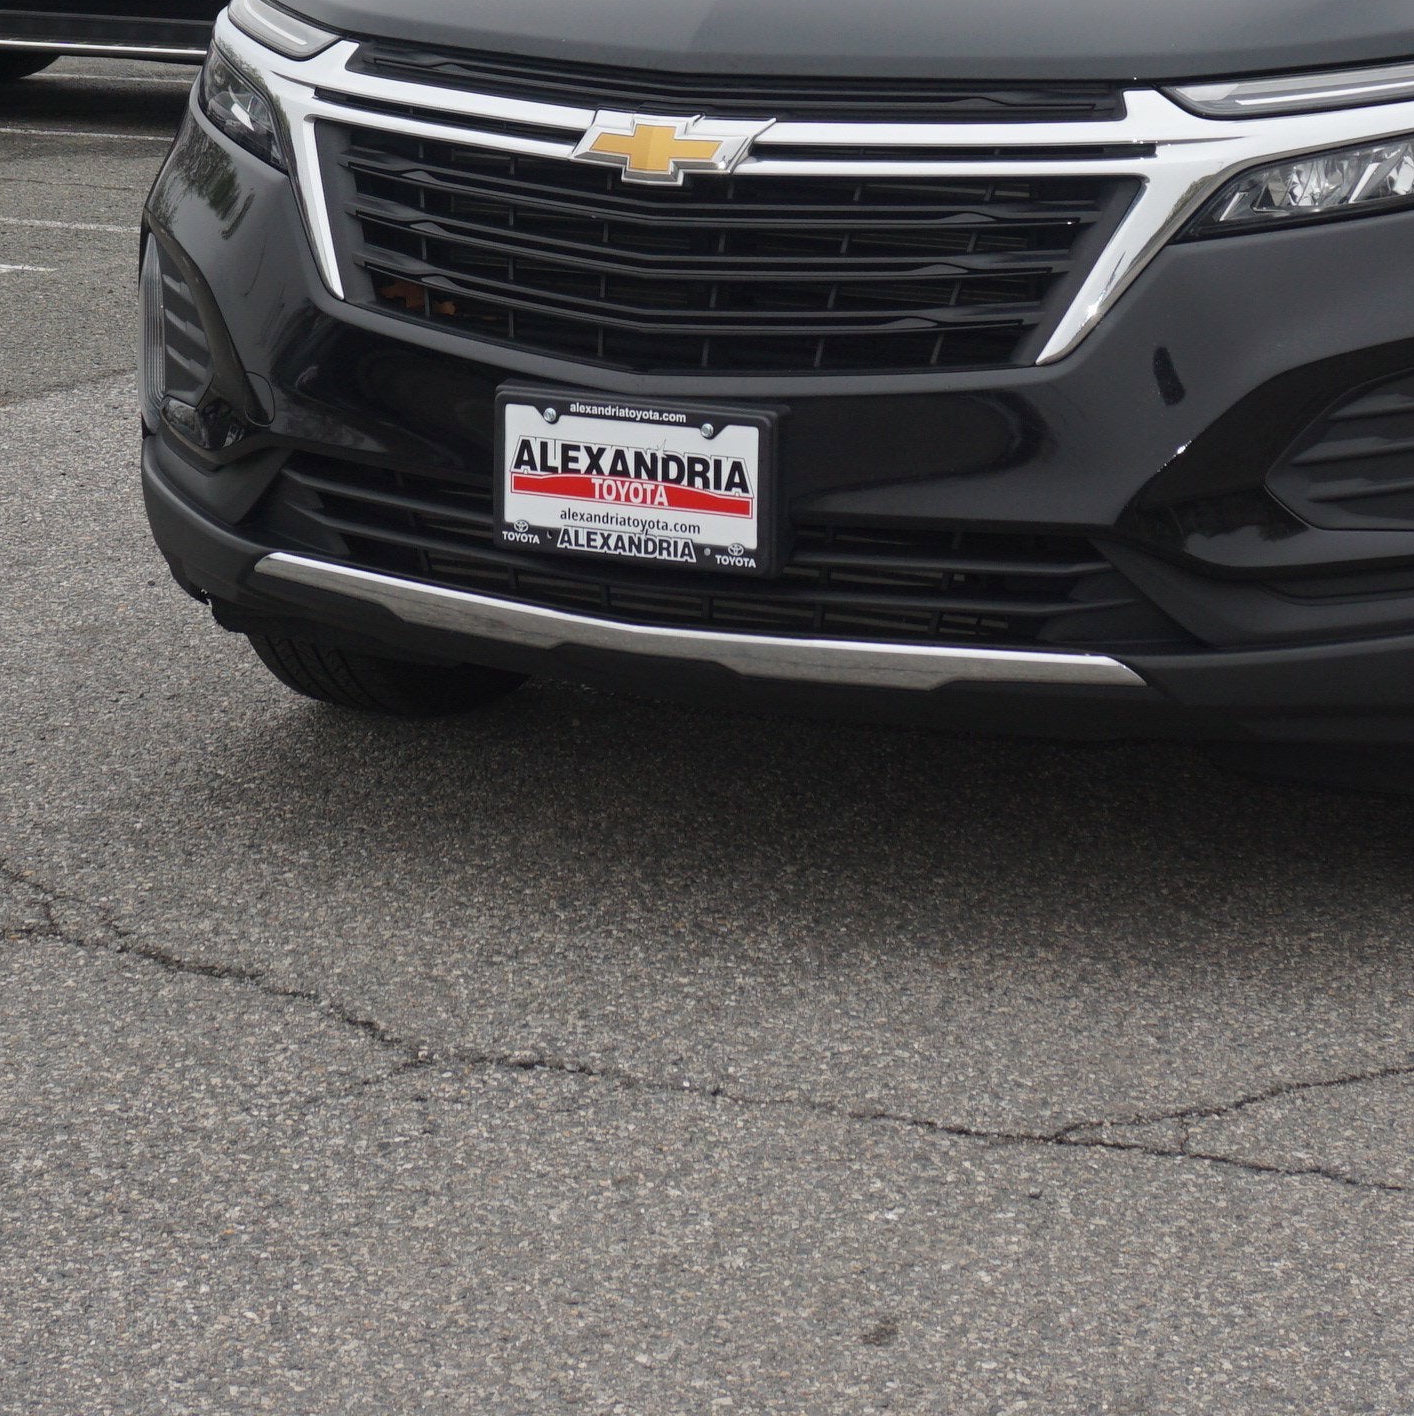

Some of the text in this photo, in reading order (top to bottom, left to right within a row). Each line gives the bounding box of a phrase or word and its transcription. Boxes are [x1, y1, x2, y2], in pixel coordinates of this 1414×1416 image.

[569, 402, 687, 424] alexandriatoyota.com
[513, 438, 751, 495] ALEXANDRIA
[591, 477, 669, 507] TOYOTA
[560, 507, 701, 535] alexandriatoyota.com
[501, 530, 540, 545] TOYOTA
[557, 527, 697, 563] ALEXANDRIA
[714, 554, 757, 569] TOYOTA
